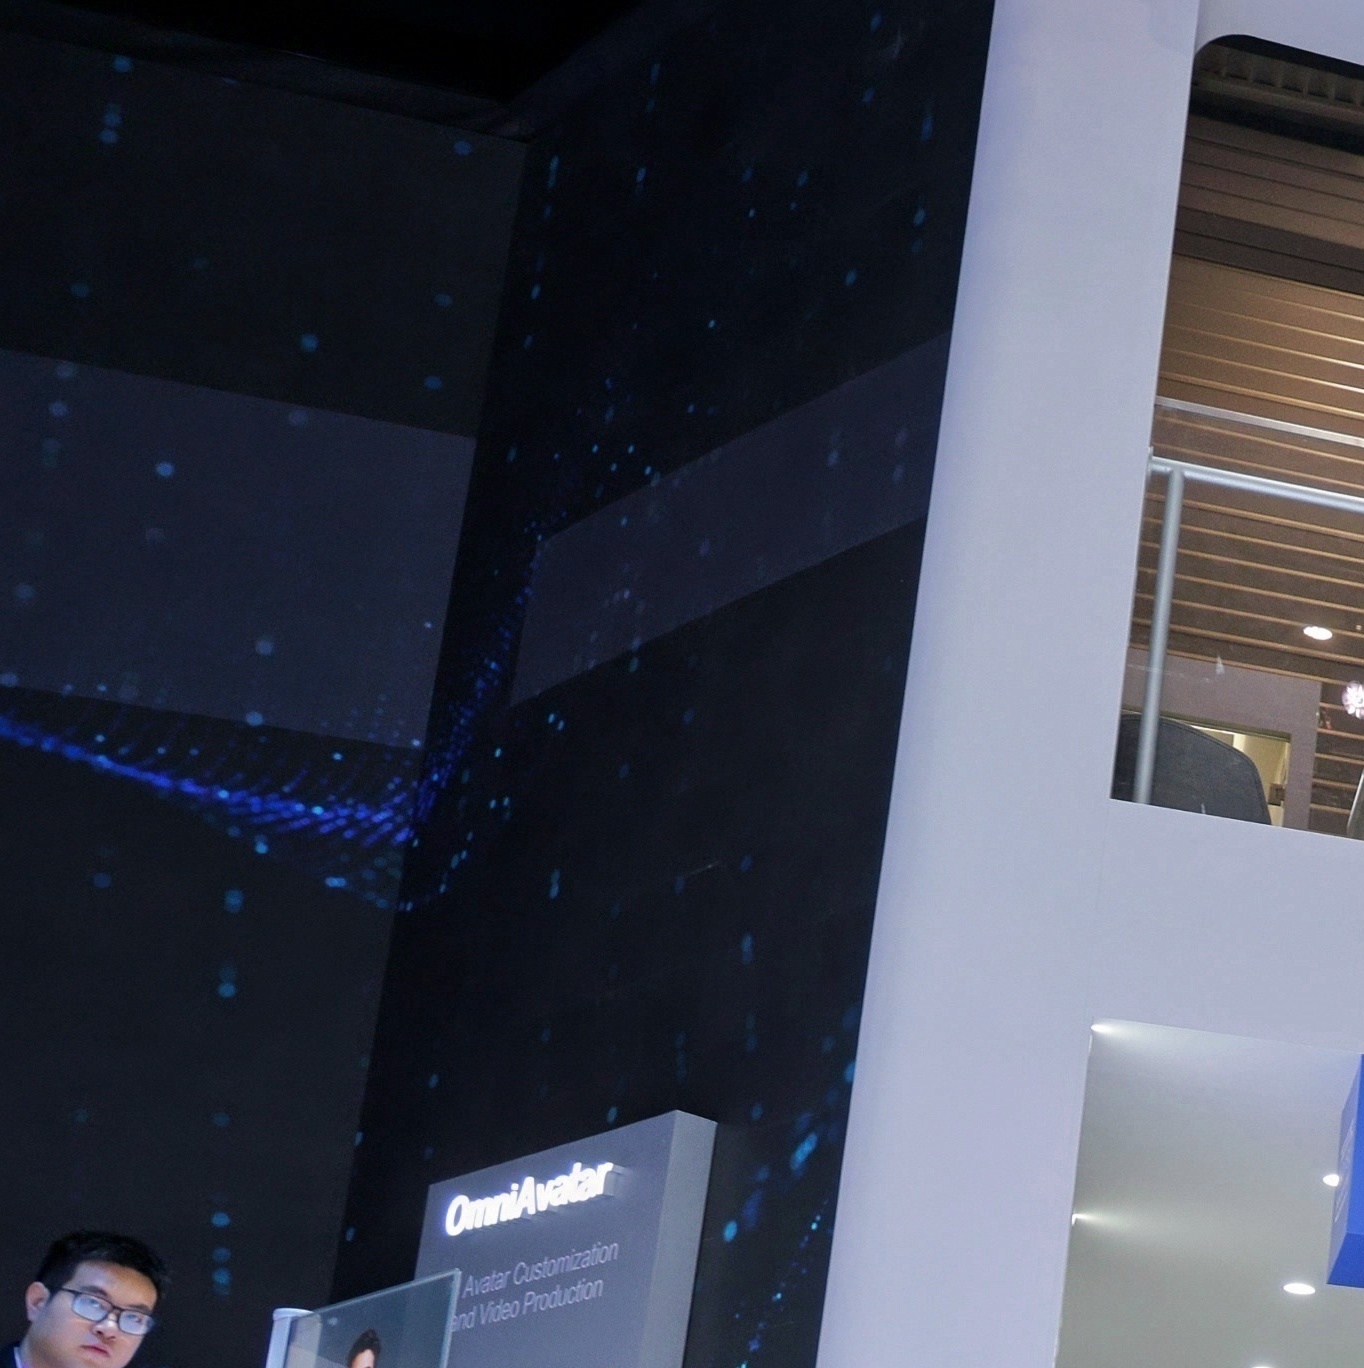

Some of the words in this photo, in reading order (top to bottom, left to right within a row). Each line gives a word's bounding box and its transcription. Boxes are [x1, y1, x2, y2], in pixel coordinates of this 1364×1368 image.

[446, 1162, 614, 1236] OmniAvatar
[461, 1269, 512, 1298] Avatar
[513, 1242, 619, 1285] Customization
[480, 1299, 519, 1325] Video
[522, 1278, 604, 1315] Production
